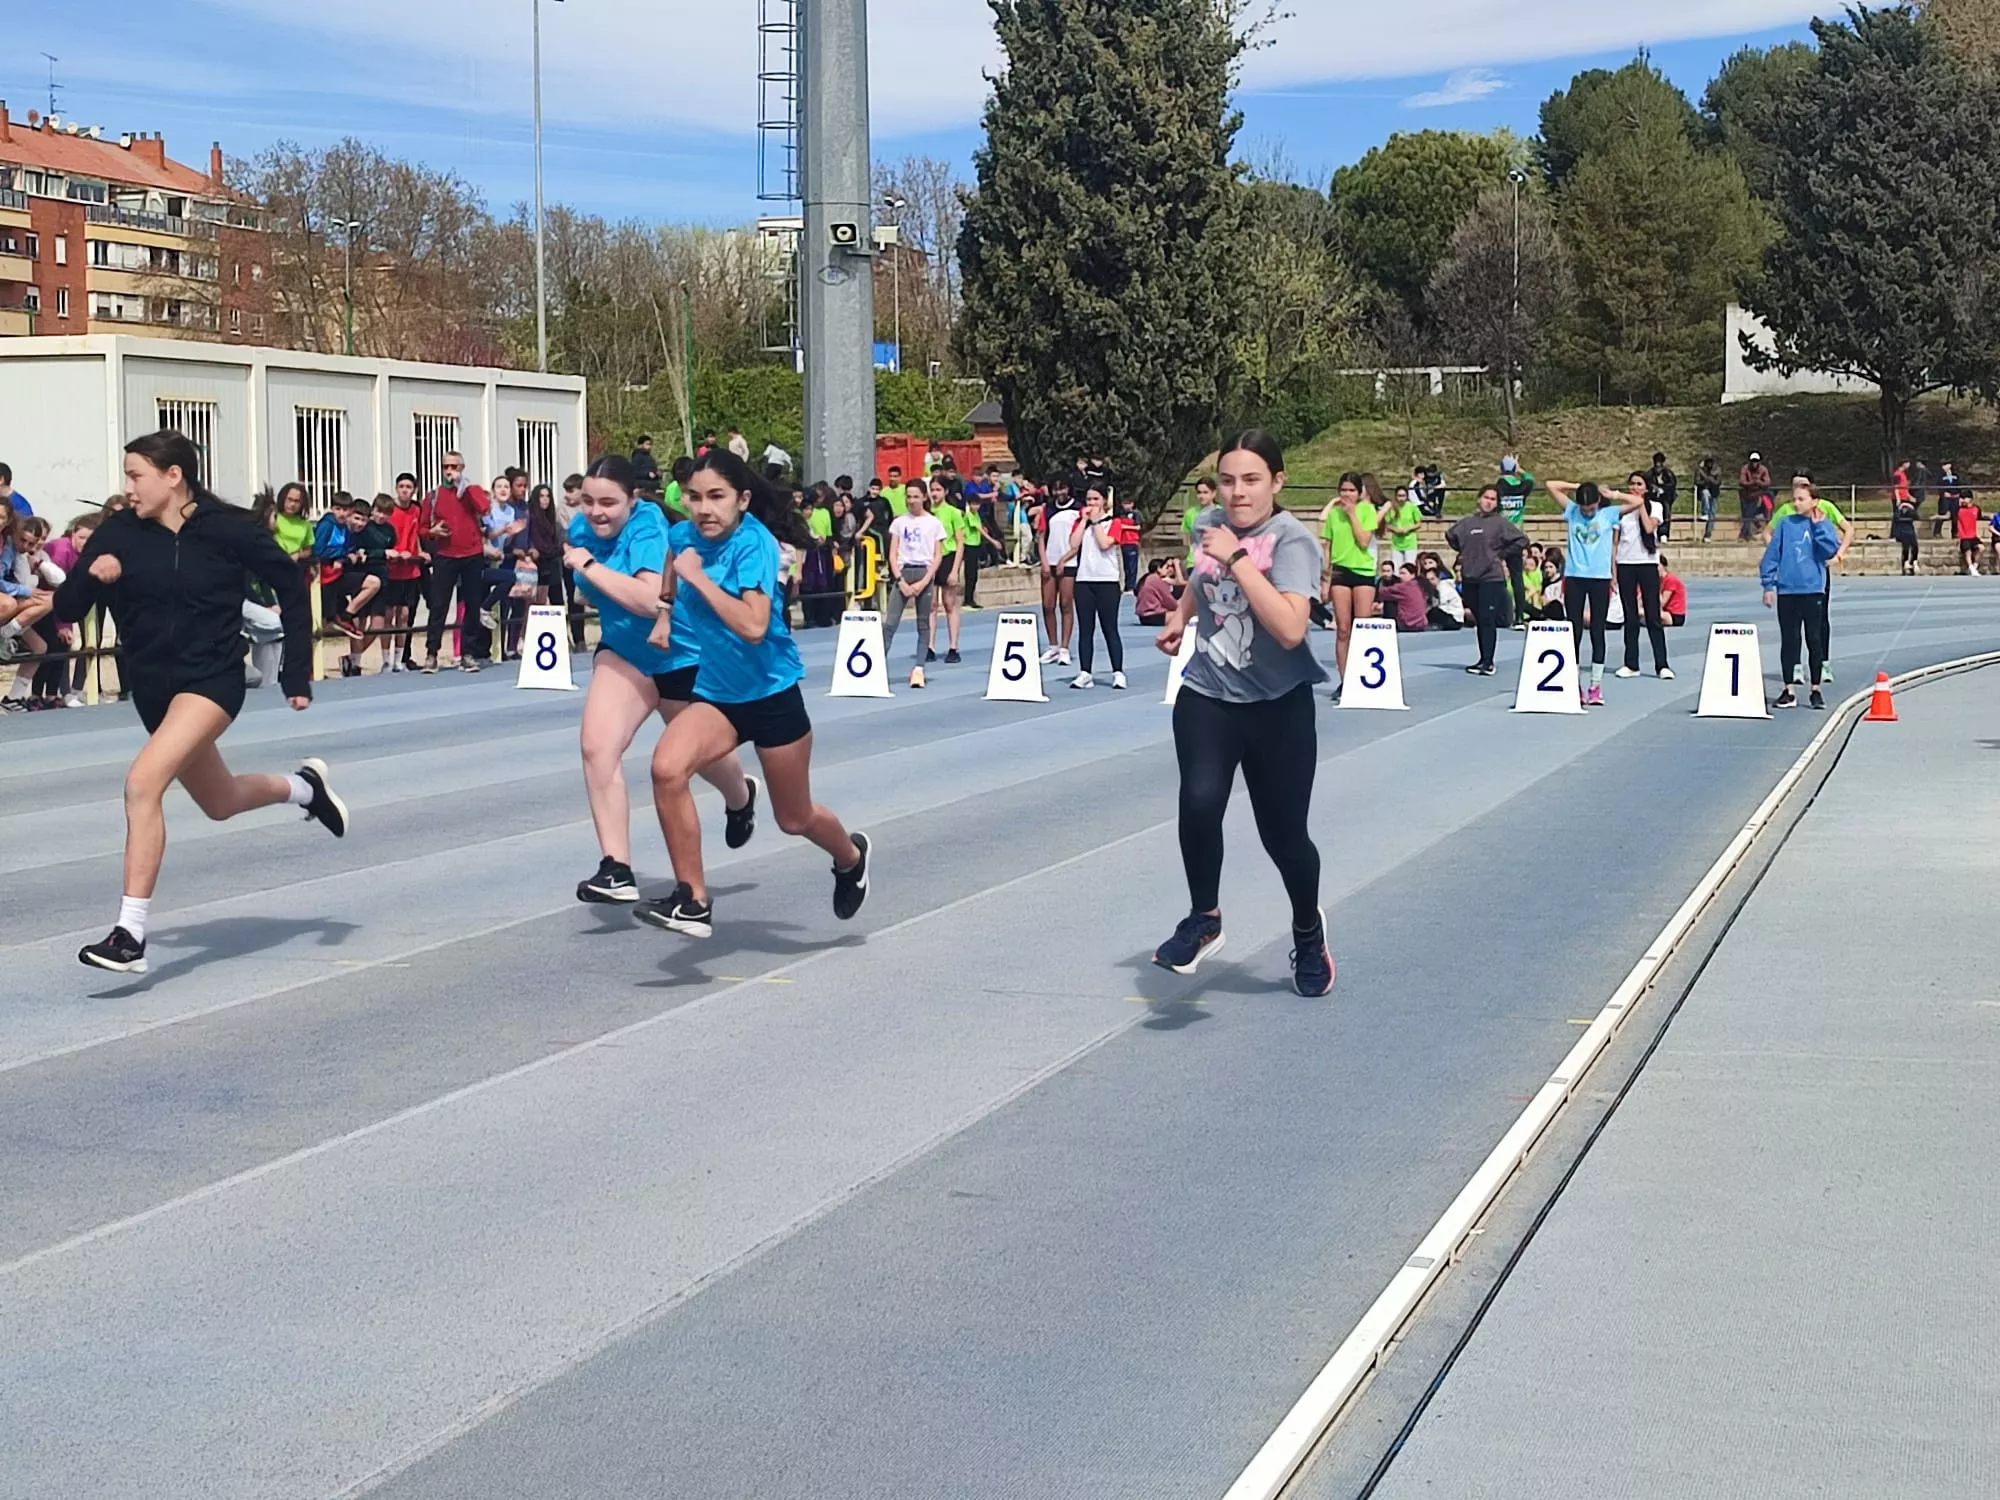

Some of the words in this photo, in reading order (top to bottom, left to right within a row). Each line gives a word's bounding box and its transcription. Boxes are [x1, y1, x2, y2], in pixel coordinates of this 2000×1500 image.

[536, 632, 557, 671] 8
[847, 638, 872, 678] 6
[1002, 641, 1027, 681] 5
[1360, 646, 1387, 689] 3
[1536, 649, 1565, 692] 2
[1724, 653, 1740, 697] 1
